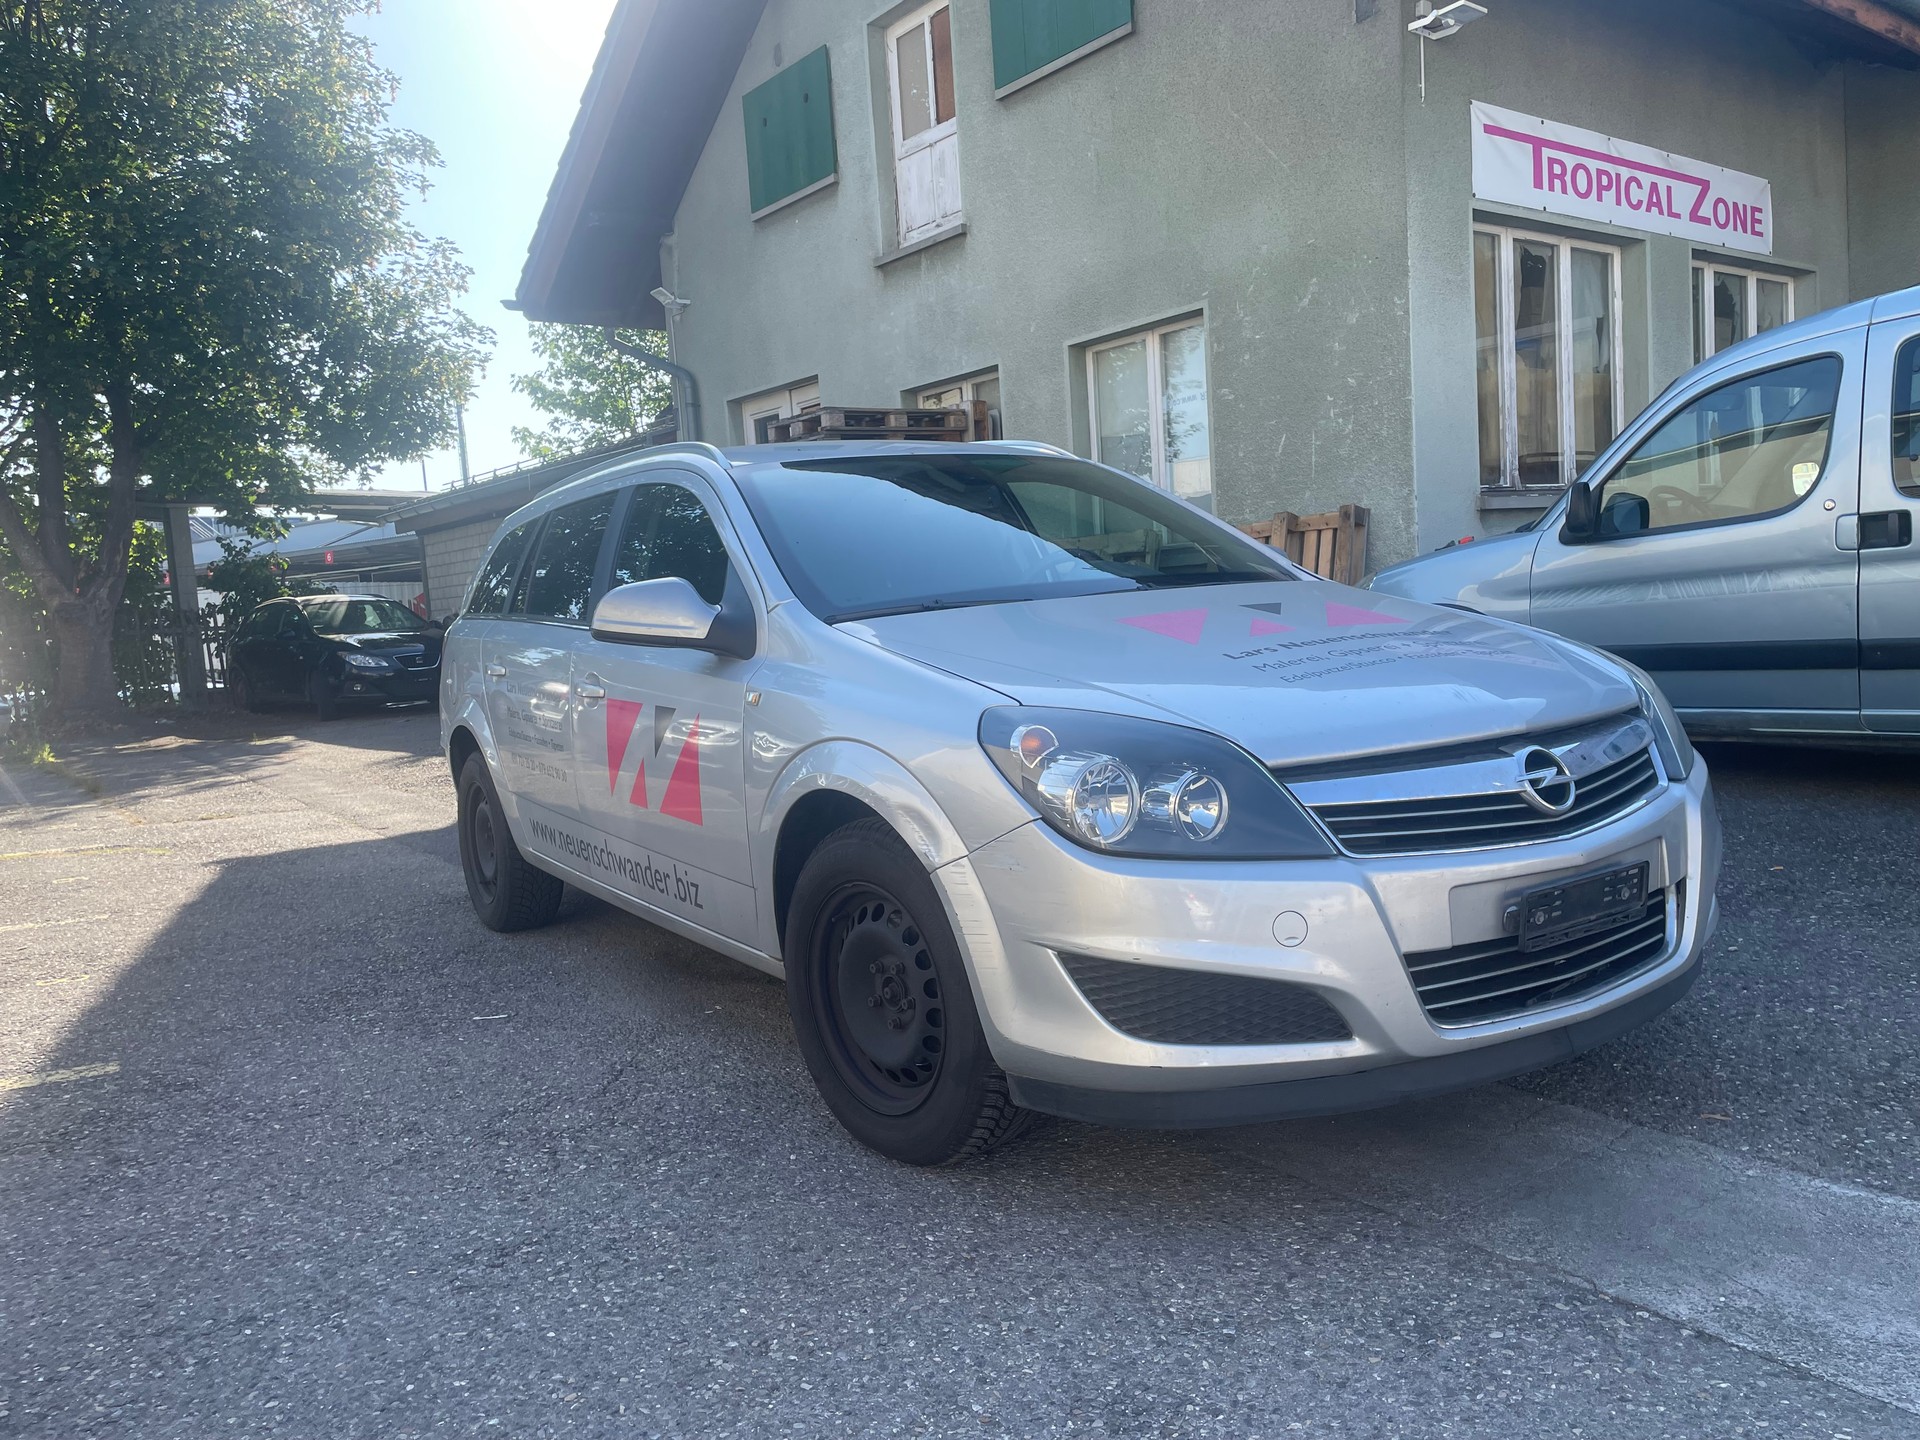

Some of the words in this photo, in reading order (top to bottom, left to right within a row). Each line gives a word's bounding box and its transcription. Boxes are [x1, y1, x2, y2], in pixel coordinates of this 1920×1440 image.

[1688, 180, 1764, 238] ZONE
[1222, 646, 1279, 660] Lars
[1251, 654, 1331, 672] Malerei,
[529, 817, 704, 910] www.neuenschwander.biz
